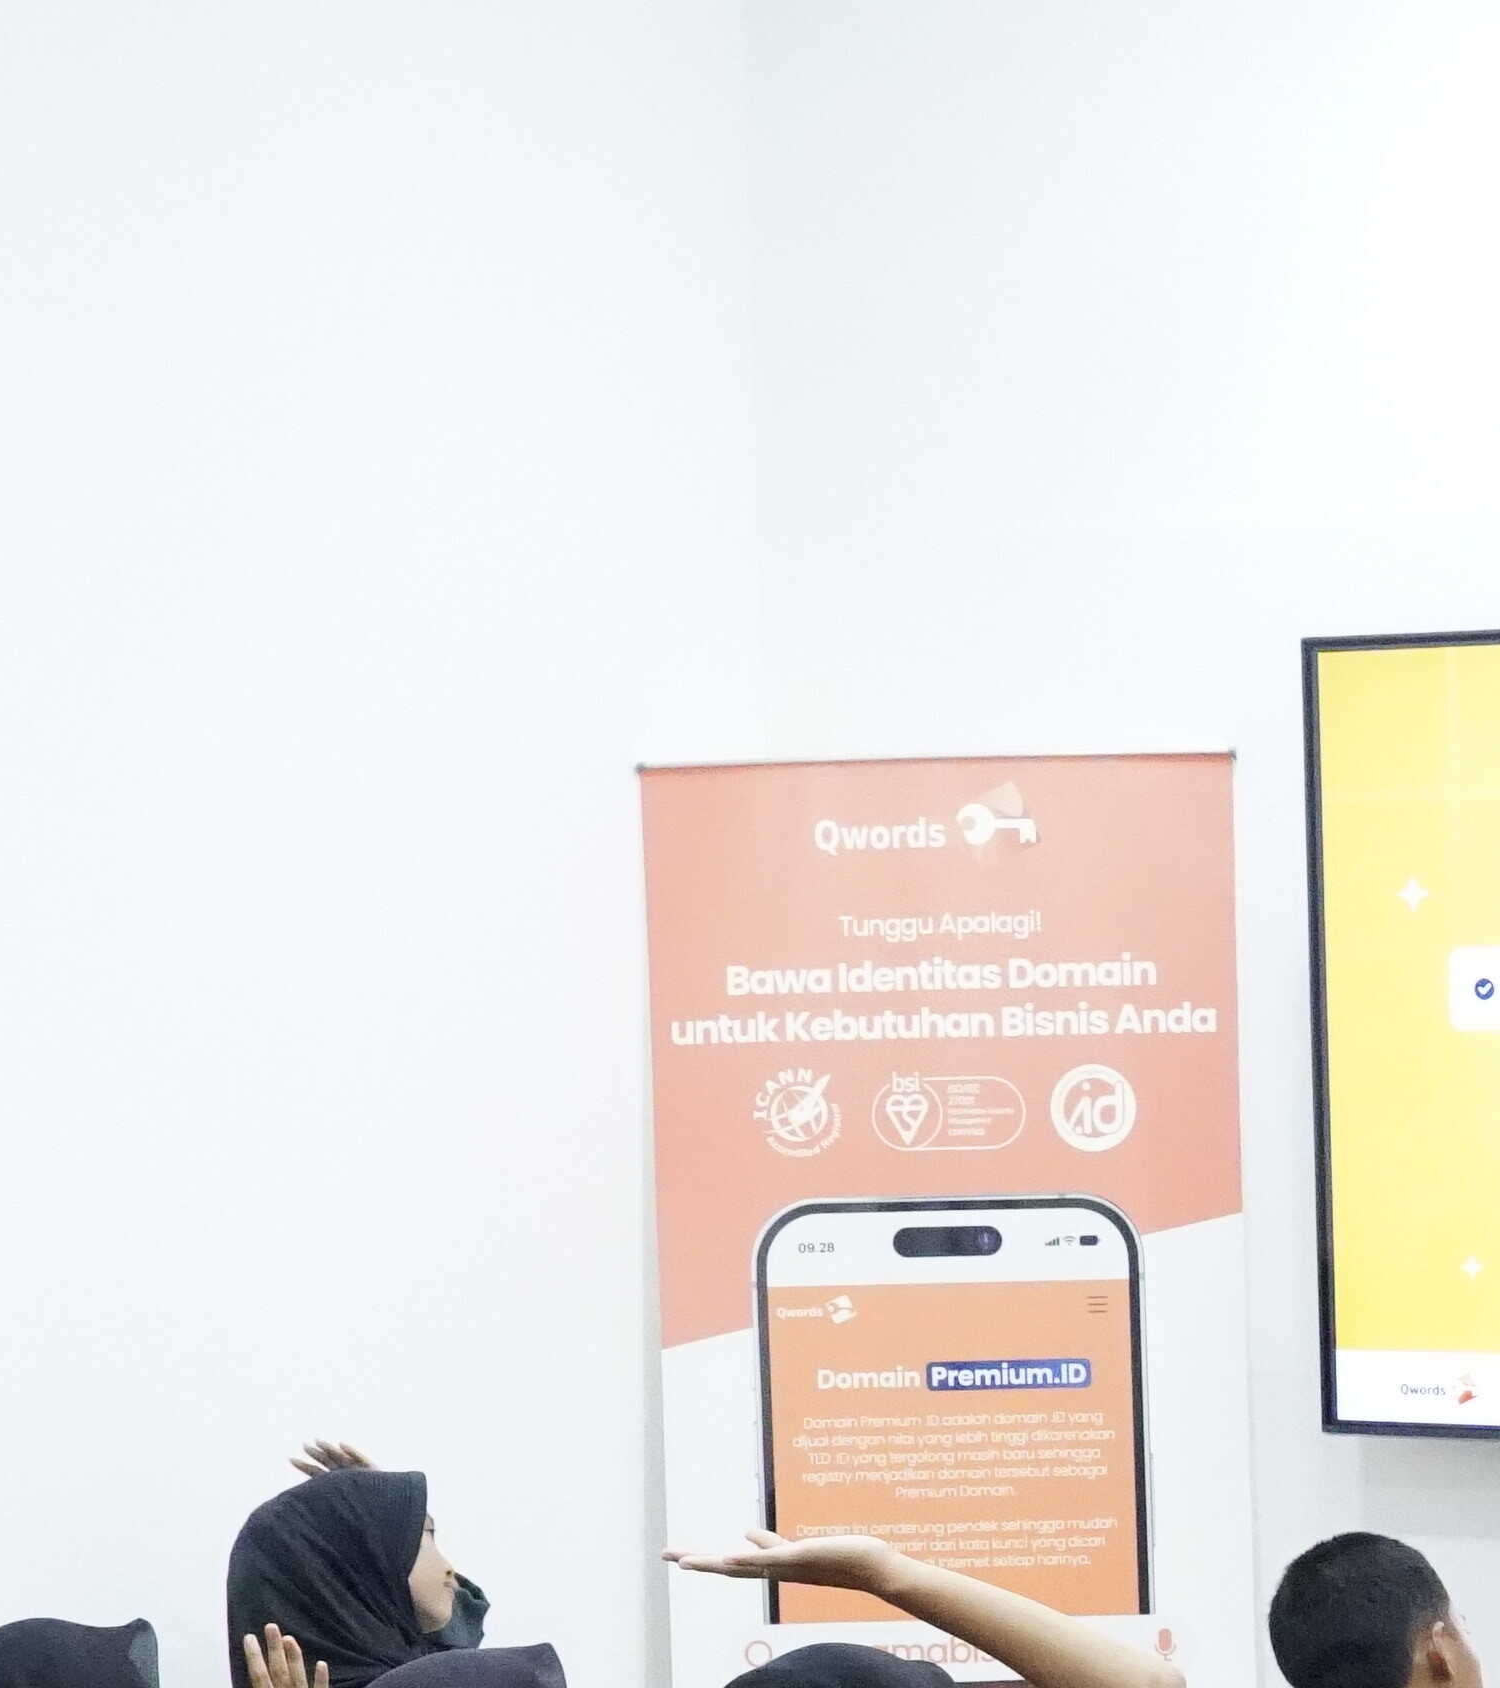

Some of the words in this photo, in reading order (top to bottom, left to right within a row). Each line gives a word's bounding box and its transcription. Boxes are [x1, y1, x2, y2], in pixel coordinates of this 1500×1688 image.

[814, 816, 947, 856] Qwords
[838, 915, 934, 942] Tunggu
[940, 910, 1042, 941] Apalagi!
[726, 965, 832, 996] Bawa
[838, 956, 1002, 993] Identitas
[1008, 951, 1157, 989] Domain
[670, 1011, 780, 1045] untuk
[785, 1006, 995, 1042] Kebutuhan
[1001, 1001, 1110, 1037] Bisnis
[1114, 1001, 1217, 1034] Anda
[753, 1067, 812, 1120] ICANN
[817, 1365, 920, 1390] Domain
[930, 1362, 1088, 1387] Premium.ID
[1400, 1383, 1446, 1396] Qwords
